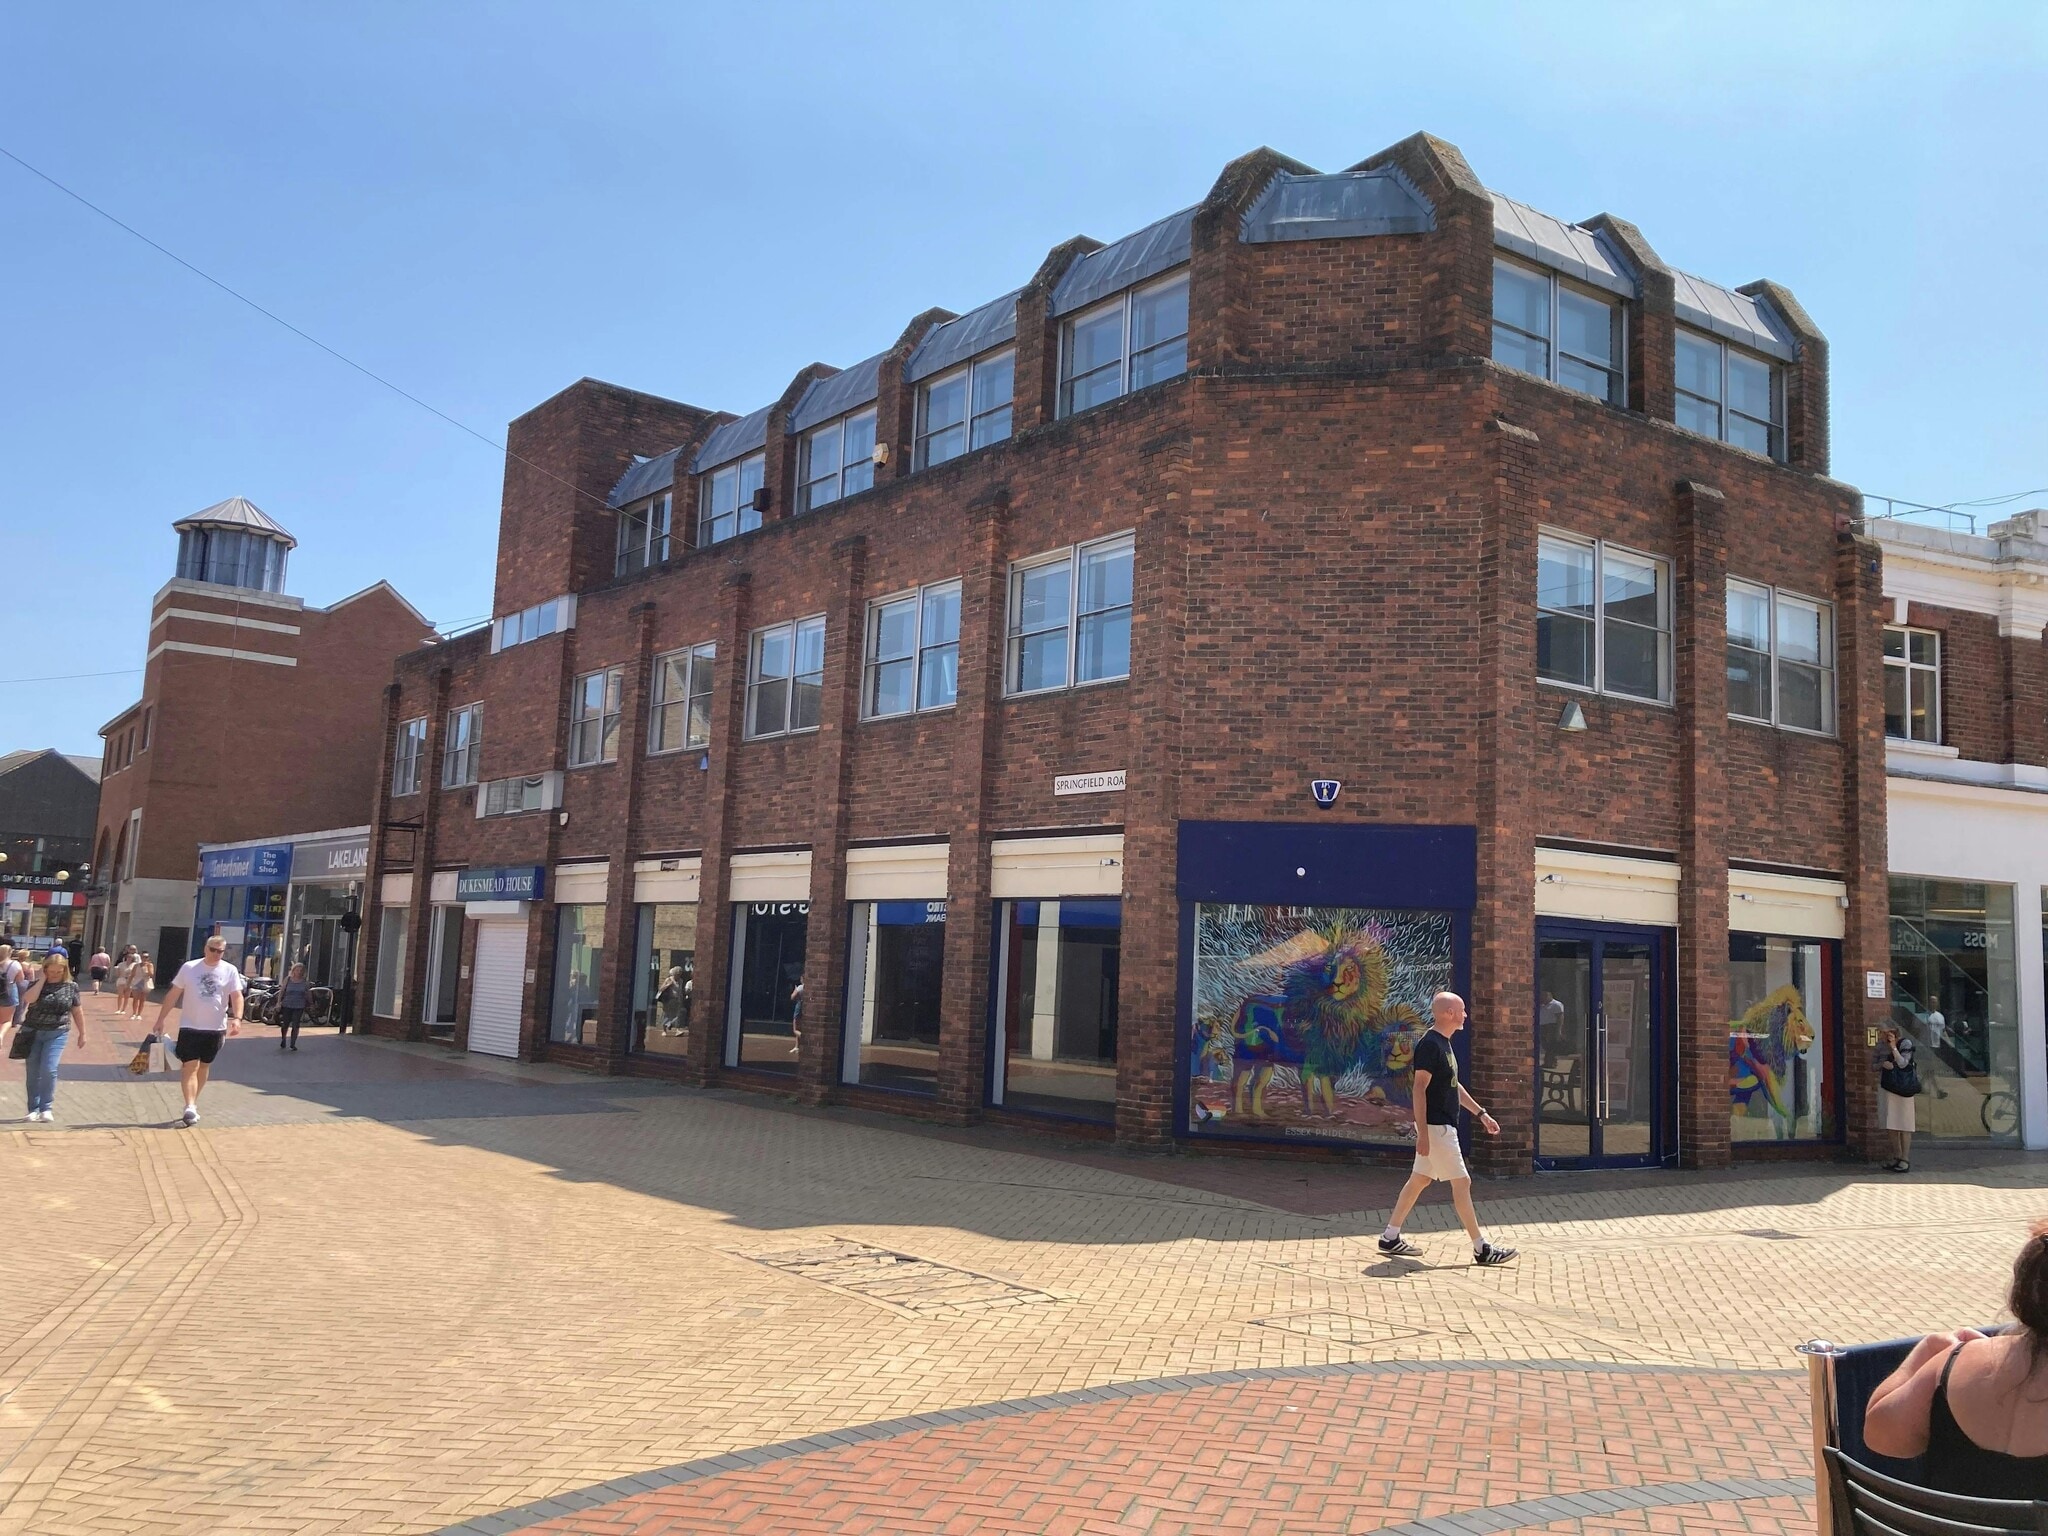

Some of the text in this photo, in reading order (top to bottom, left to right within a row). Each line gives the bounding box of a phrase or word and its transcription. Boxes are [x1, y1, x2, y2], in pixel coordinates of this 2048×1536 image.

[1056, 777, 1105, 790] SPRINGFIELD
[262, 851, 277, 860] The
[212, 856, 250, 878] Entertainer
[263, 859, 276, 867] Toy
[259, 866, 279, 875] Shop
[2, 874, 33, 884] SMKE
[34, 876, 40, 884] &
[459, 876, 533, 893] DUKESMEAD HOUSE
[1285, 1127, 1311, 1136] ESSEX
[1315, 1128, 1343, 1138] PRIDE
